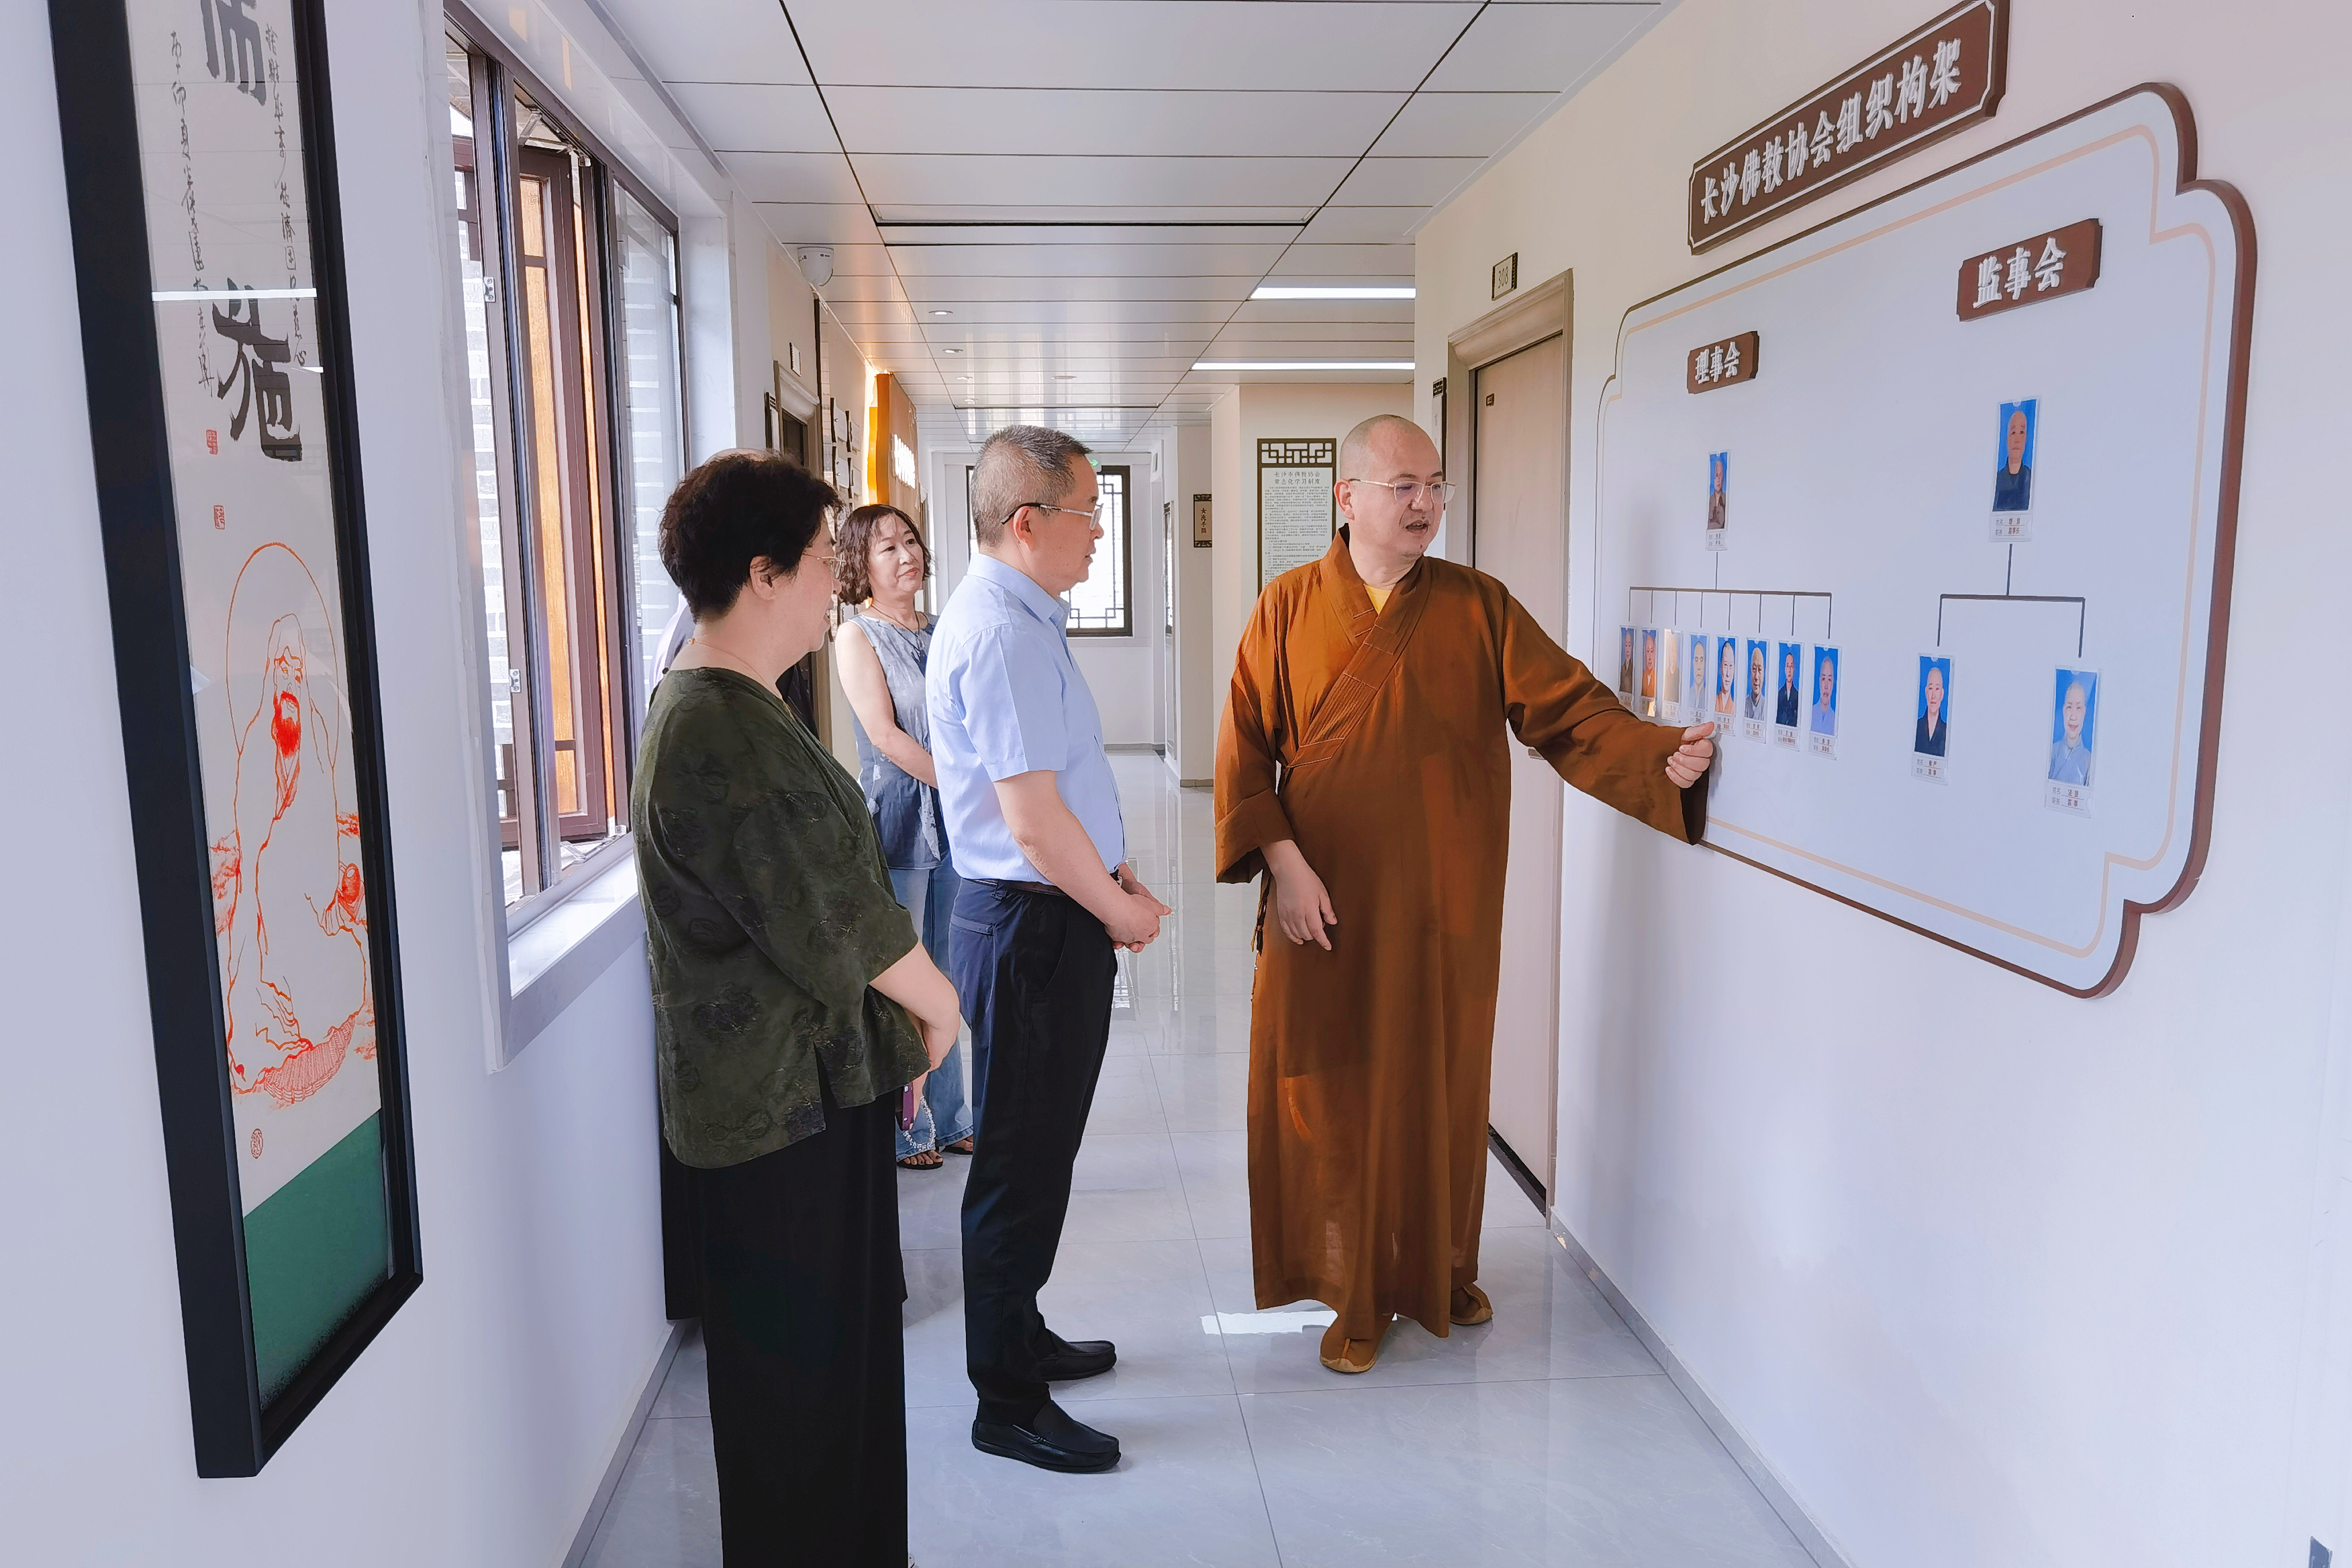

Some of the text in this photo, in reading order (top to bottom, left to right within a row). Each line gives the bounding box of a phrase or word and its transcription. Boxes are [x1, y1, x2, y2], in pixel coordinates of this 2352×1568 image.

[1700, 38, 1962, 224] 长沙佛教协会组织构架
[1498, 266, 1508, 289] 308
[1973, 237, 2067, 309] 监事会
[1695, 340, 1740, 385] 理事会
